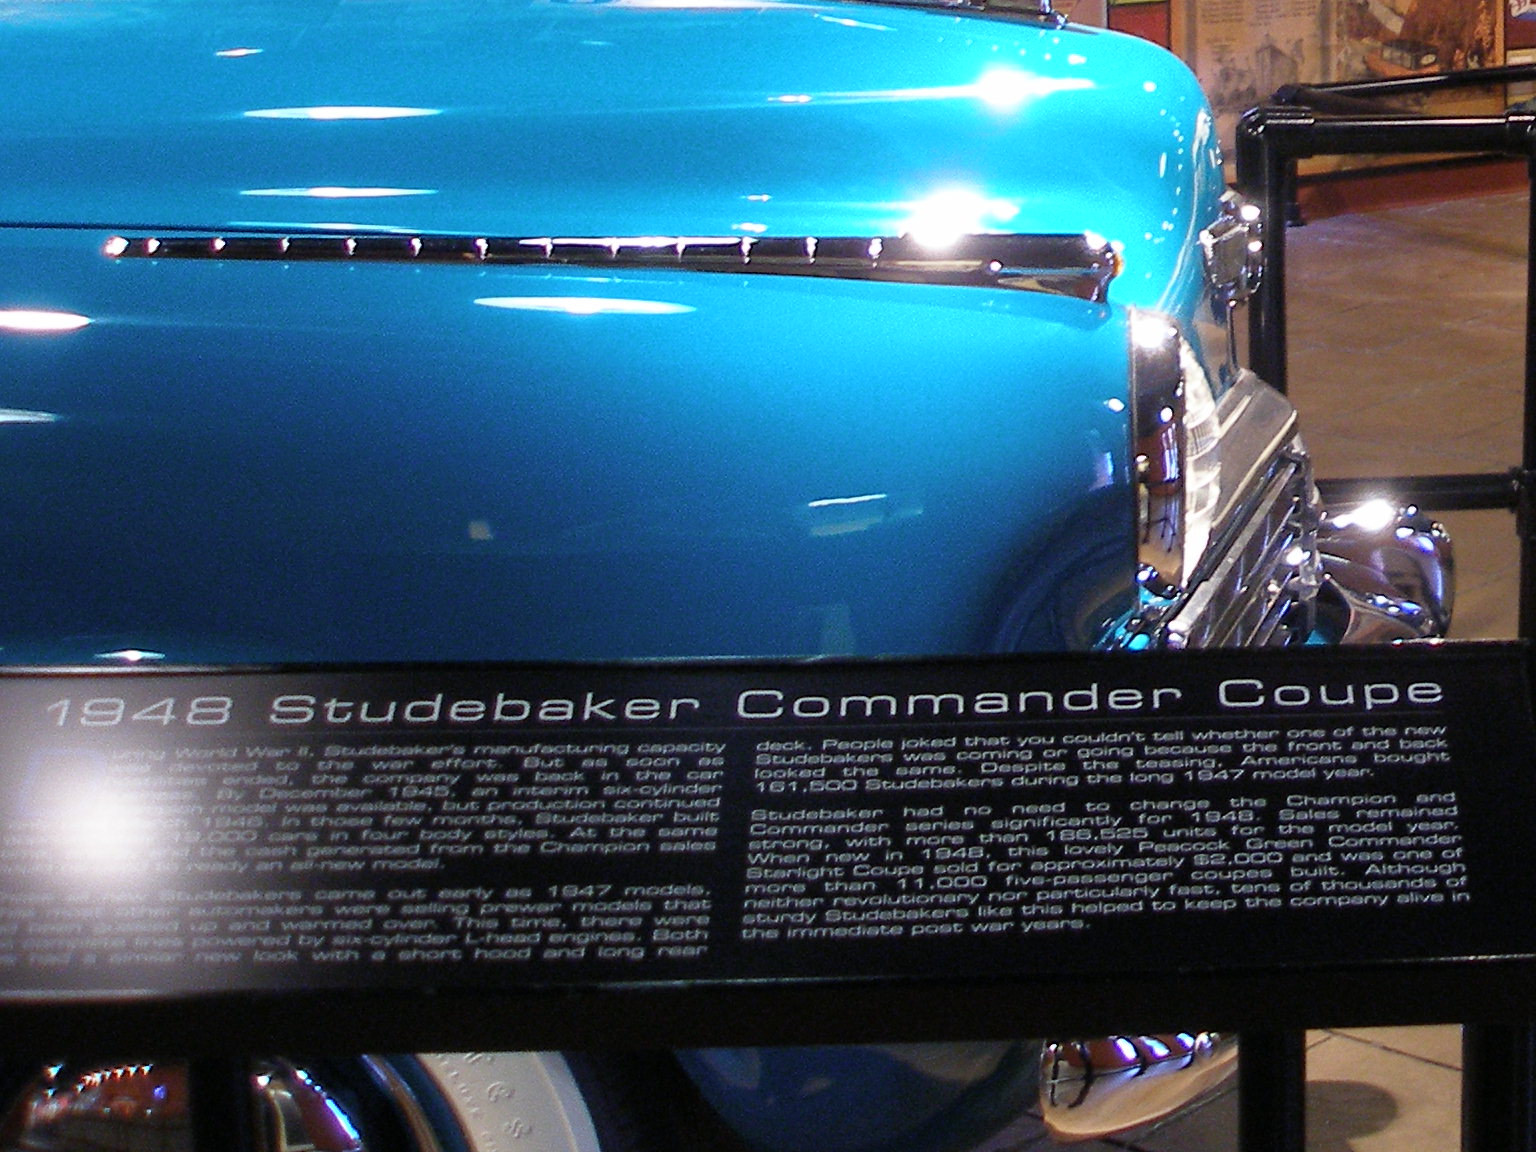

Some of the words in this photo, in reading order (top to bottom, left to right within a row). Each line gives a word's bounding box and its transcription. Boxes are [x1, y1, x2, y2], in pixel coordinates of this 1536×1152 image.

[46, 696, 233, 727] 1948
[269, 691, 702, 725] Studebaker
[735, 680, 1183, 720] Commander
[1217, 677, 1445, 715] Coupe
[324, 741, 466, 758] Studebaker's
[473, 742, 631, 757] manufacturing
[637, 740, 727, 755] capacity
[865, 774, 1004, 790] Studebakers
[1010, 772, 1079, 790] during
[1086, 771, 1123, 785] the
[1129, 770, 1174, 787] long
[1252, 767, 1316, 781] model
[747, 849, 810, 864] When
[825, 849, 871, 862] new
[885, 847, 904, 861] in
[1007, 843, 1049, 857] this
[1064, 841, 1124, 859] lovely
[1138, 838, 1230, 854] Peacock
[1245, 836, 1314, 851] Green
[1328, 832, 1463, 849] Commander
[253, 948, 298, 962] look
[312, 947, 360, 961] with
[371, 949, 386, 961] a
[398, 946, 462, 960] short
[474, 946, 532, 960] hood
[543, 945, 586, 959] and
[597, 944, 645, 961] long
[657, 945, 708, 958] rear
